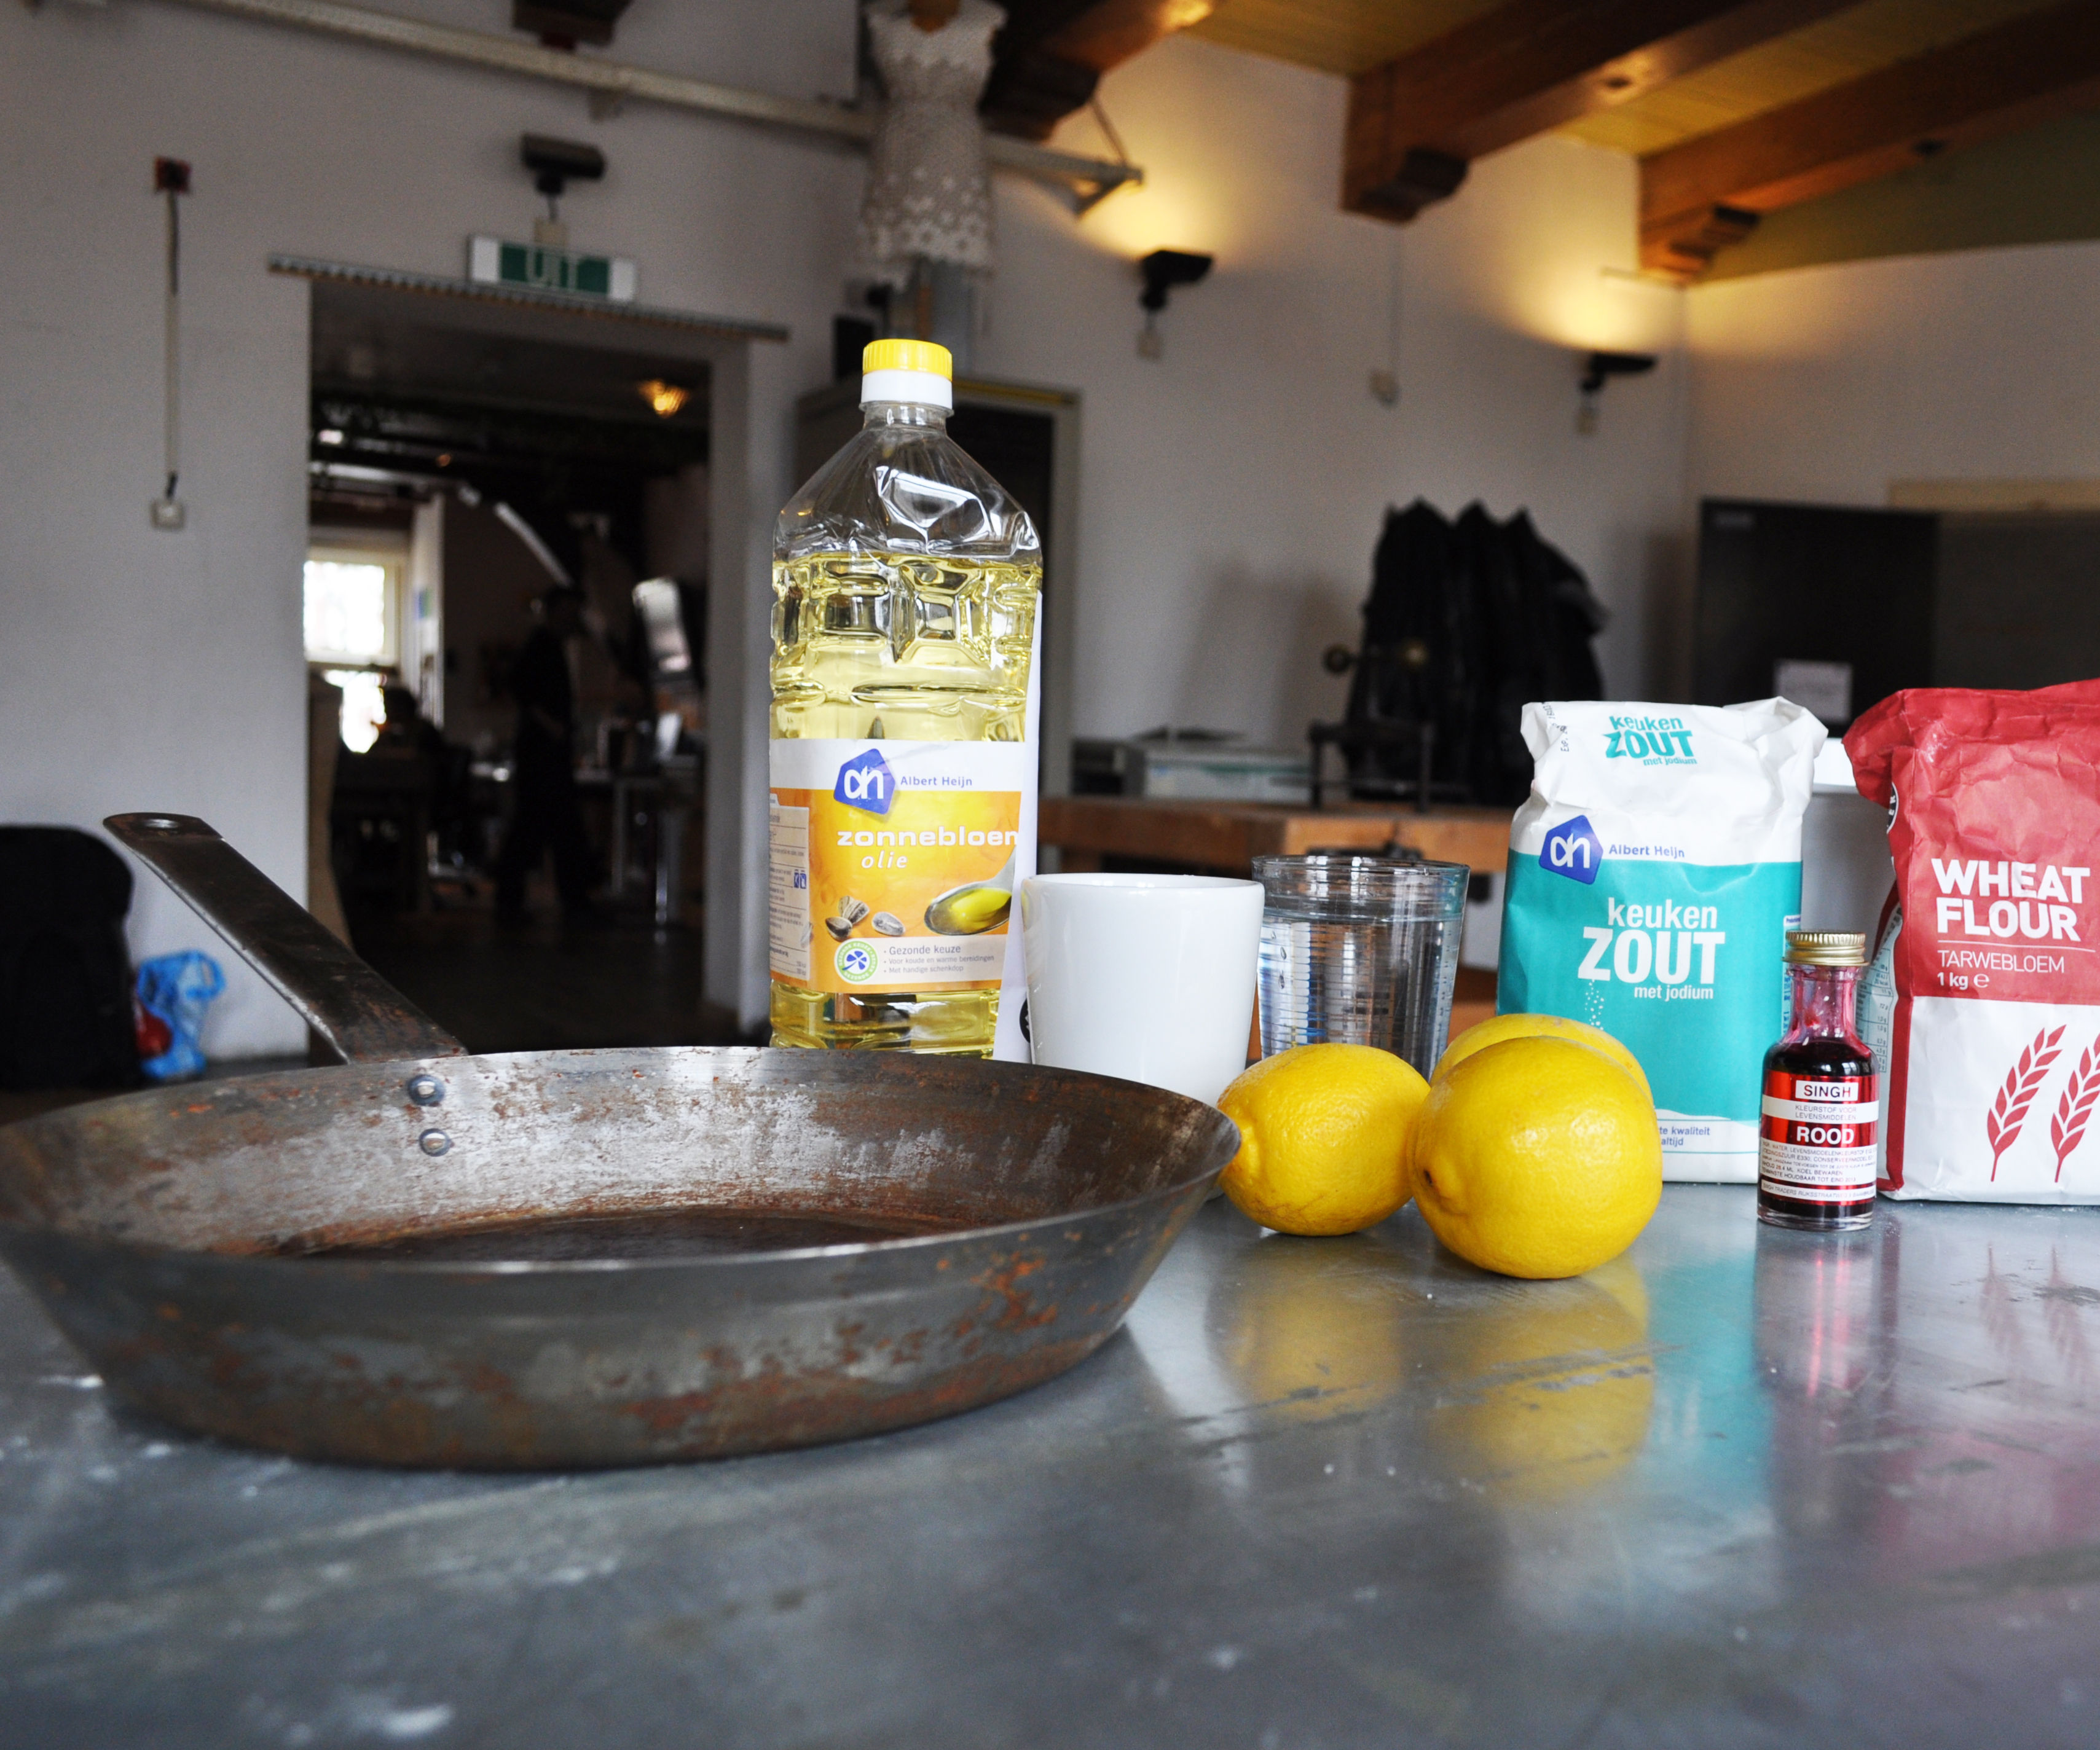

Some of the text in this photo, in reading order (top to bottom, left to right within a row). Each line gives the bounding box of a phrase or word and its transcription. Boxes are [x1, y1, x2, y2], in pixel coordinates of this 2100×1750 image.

[1609, 716, 1683, 731] keuken
[1602, 729, 1693, 758] ZOUT
[1643, 756, 1697, 766] met jodium
[900, 776, 972, 788] Albert Heijn
[861, 850, 908, 869] olie
[1609, 844, 1685, 860] Albert Heijn
[1931, 858, 2091, 904] WHEAT
[1608, 897, 1718, 929] keuken
[1936, 897, 2082, 942] FLOUR
[889, 944, 961, 955] Gezonde keuze
[1578, 926, 1726, 984] ZOUT
[1937, 950, 2065, 974] TARWEBLOEM
[1937, 972, 1945, 987] 1
[1949, 972, 1969, 991] kg
[1634, 984, 1714, 1002] met jodium
[1804, 1085, 1851, 1098] SINGH
[1672, 1126, 1710, 1136] kwaliteit
[1796, 1126, 1855, 1145] ROOD
[1661, 1137, 1684, 1147] altijd
